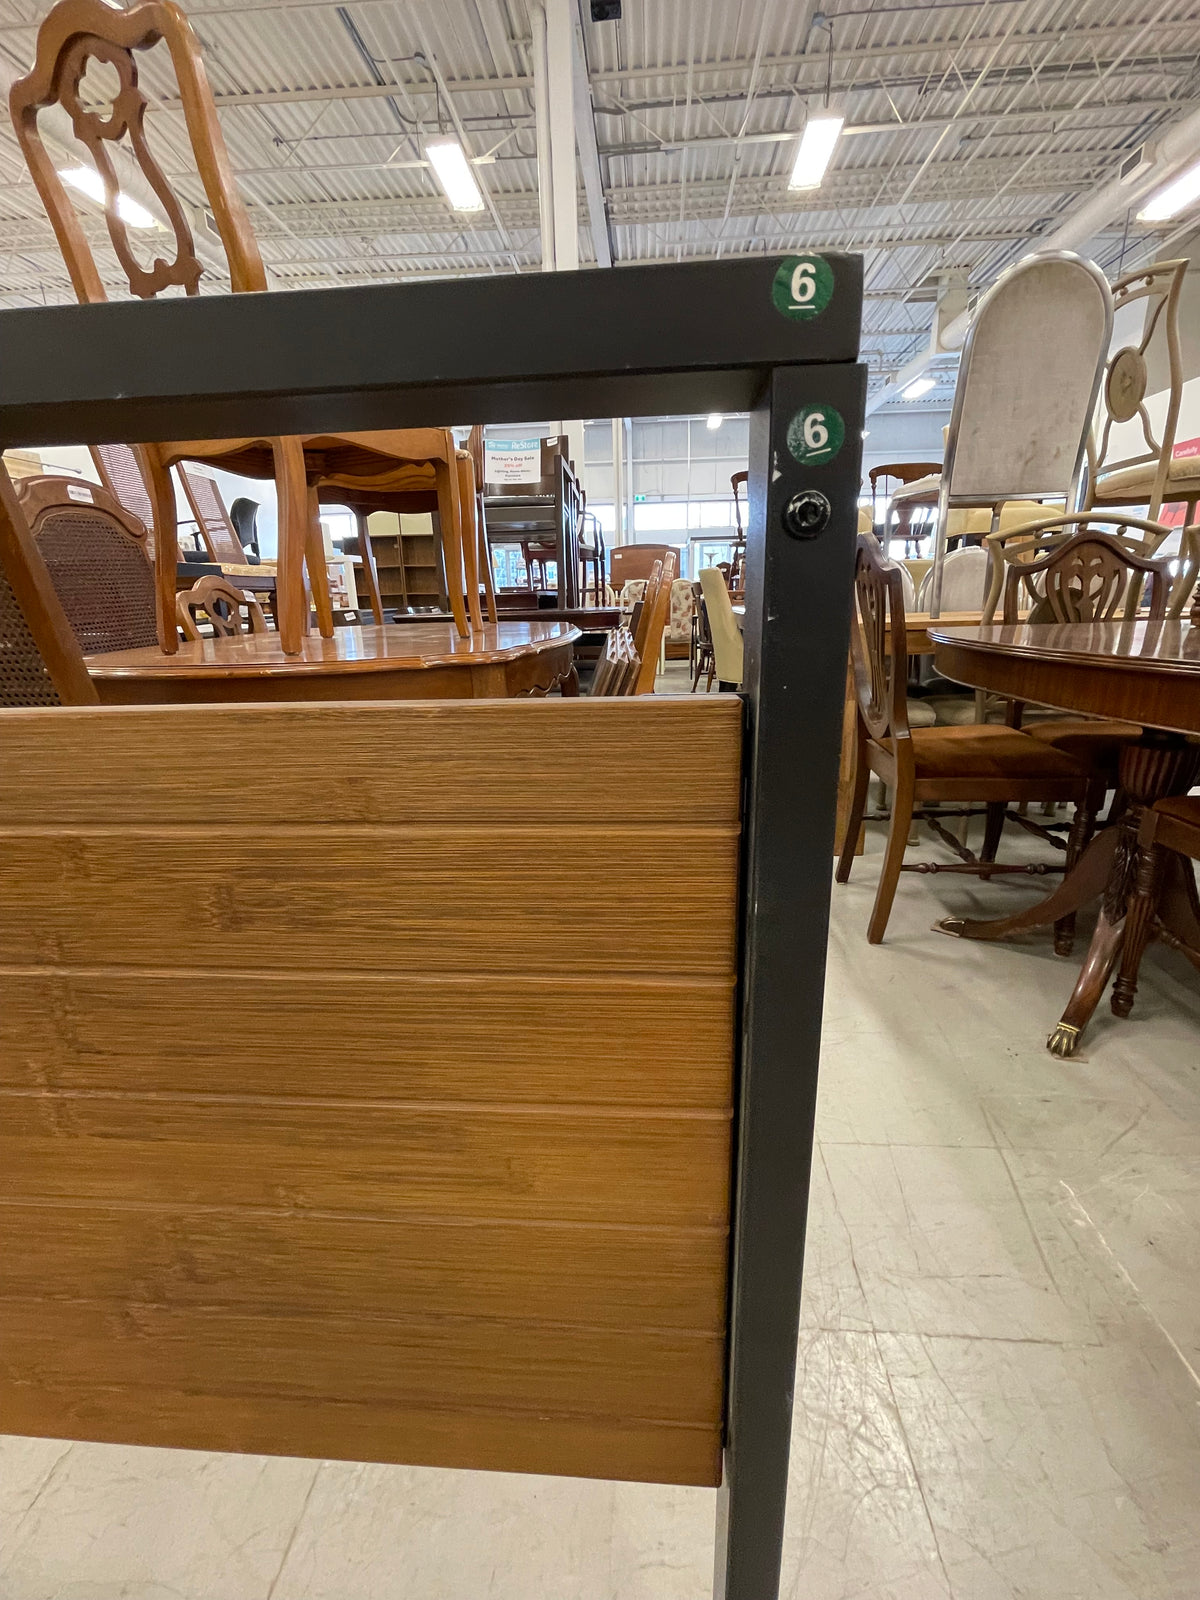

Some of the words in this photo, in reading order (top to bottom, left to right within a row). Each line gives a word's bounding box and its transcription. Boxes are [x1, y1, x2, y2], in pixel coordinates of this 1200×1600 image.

[791, 262, 816, 302] 6
[511, 441, 539, 449] ReStore
[803, 412, 829, 448] 6
